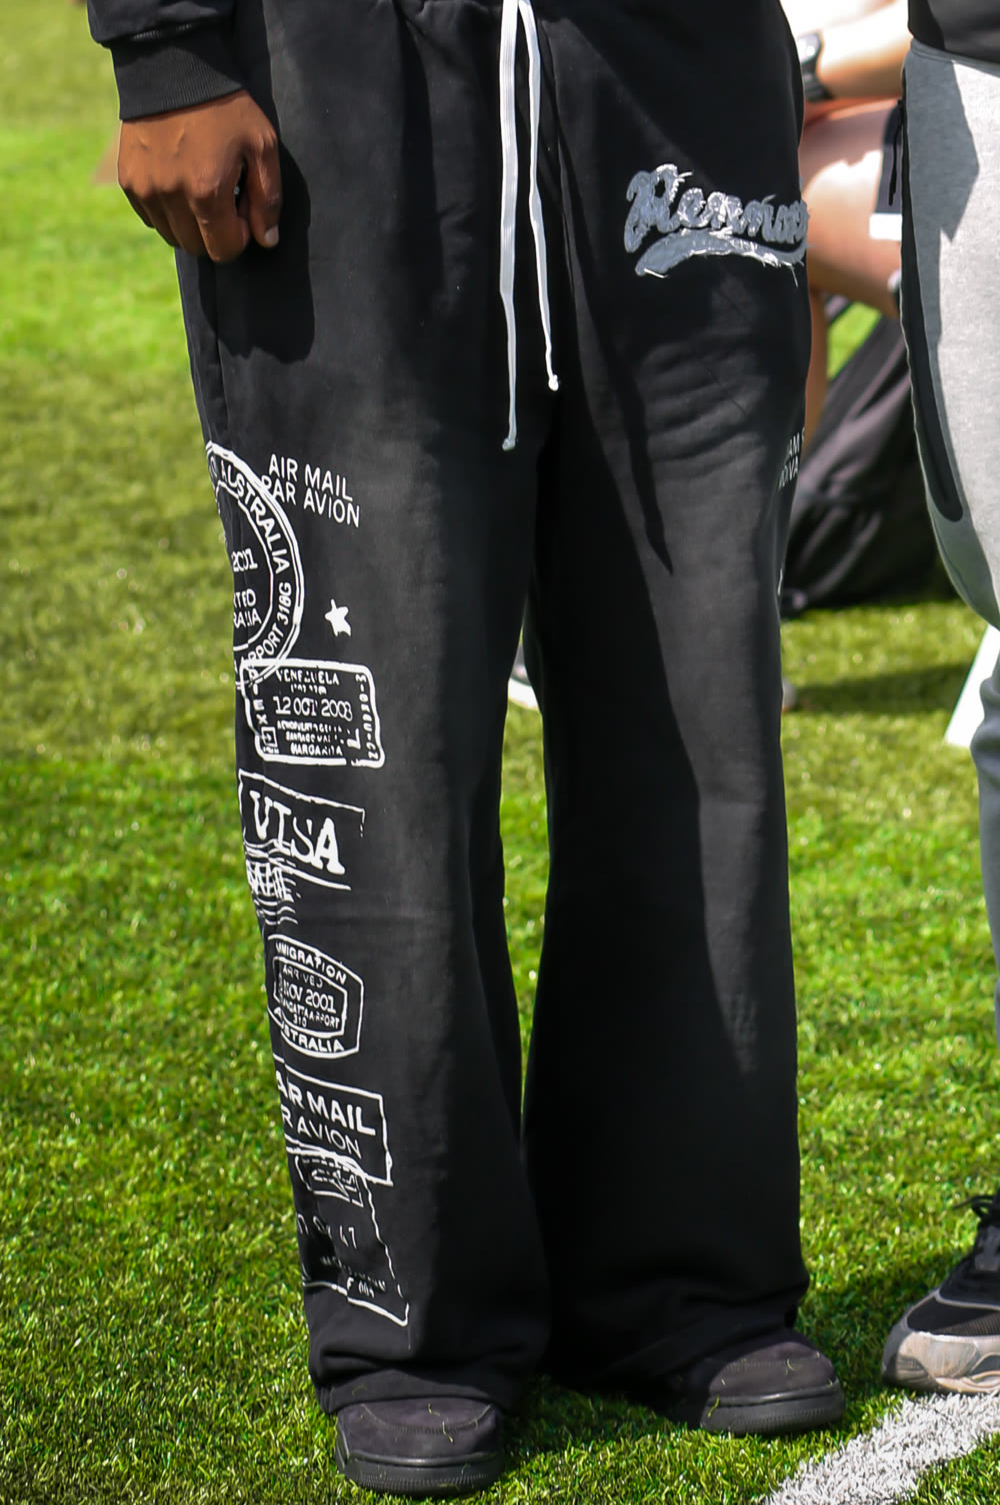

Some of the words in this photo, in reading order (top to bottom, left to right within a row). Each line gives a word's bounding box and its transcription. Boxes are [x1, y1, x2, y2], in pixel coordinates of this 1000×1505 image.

[268, 453, 299, 482] AIR
[304, 463, 354, 502] MAIL
[261, 475, 297, 506] PAR
[303, 488, 360, 528] AVION
[273, 696, 291, 715] 12
[305, 989, 336, 1013] 2001
[307, 1090, 376, 1136] MAIL
[297, 1116, 362, 1159] AVION
